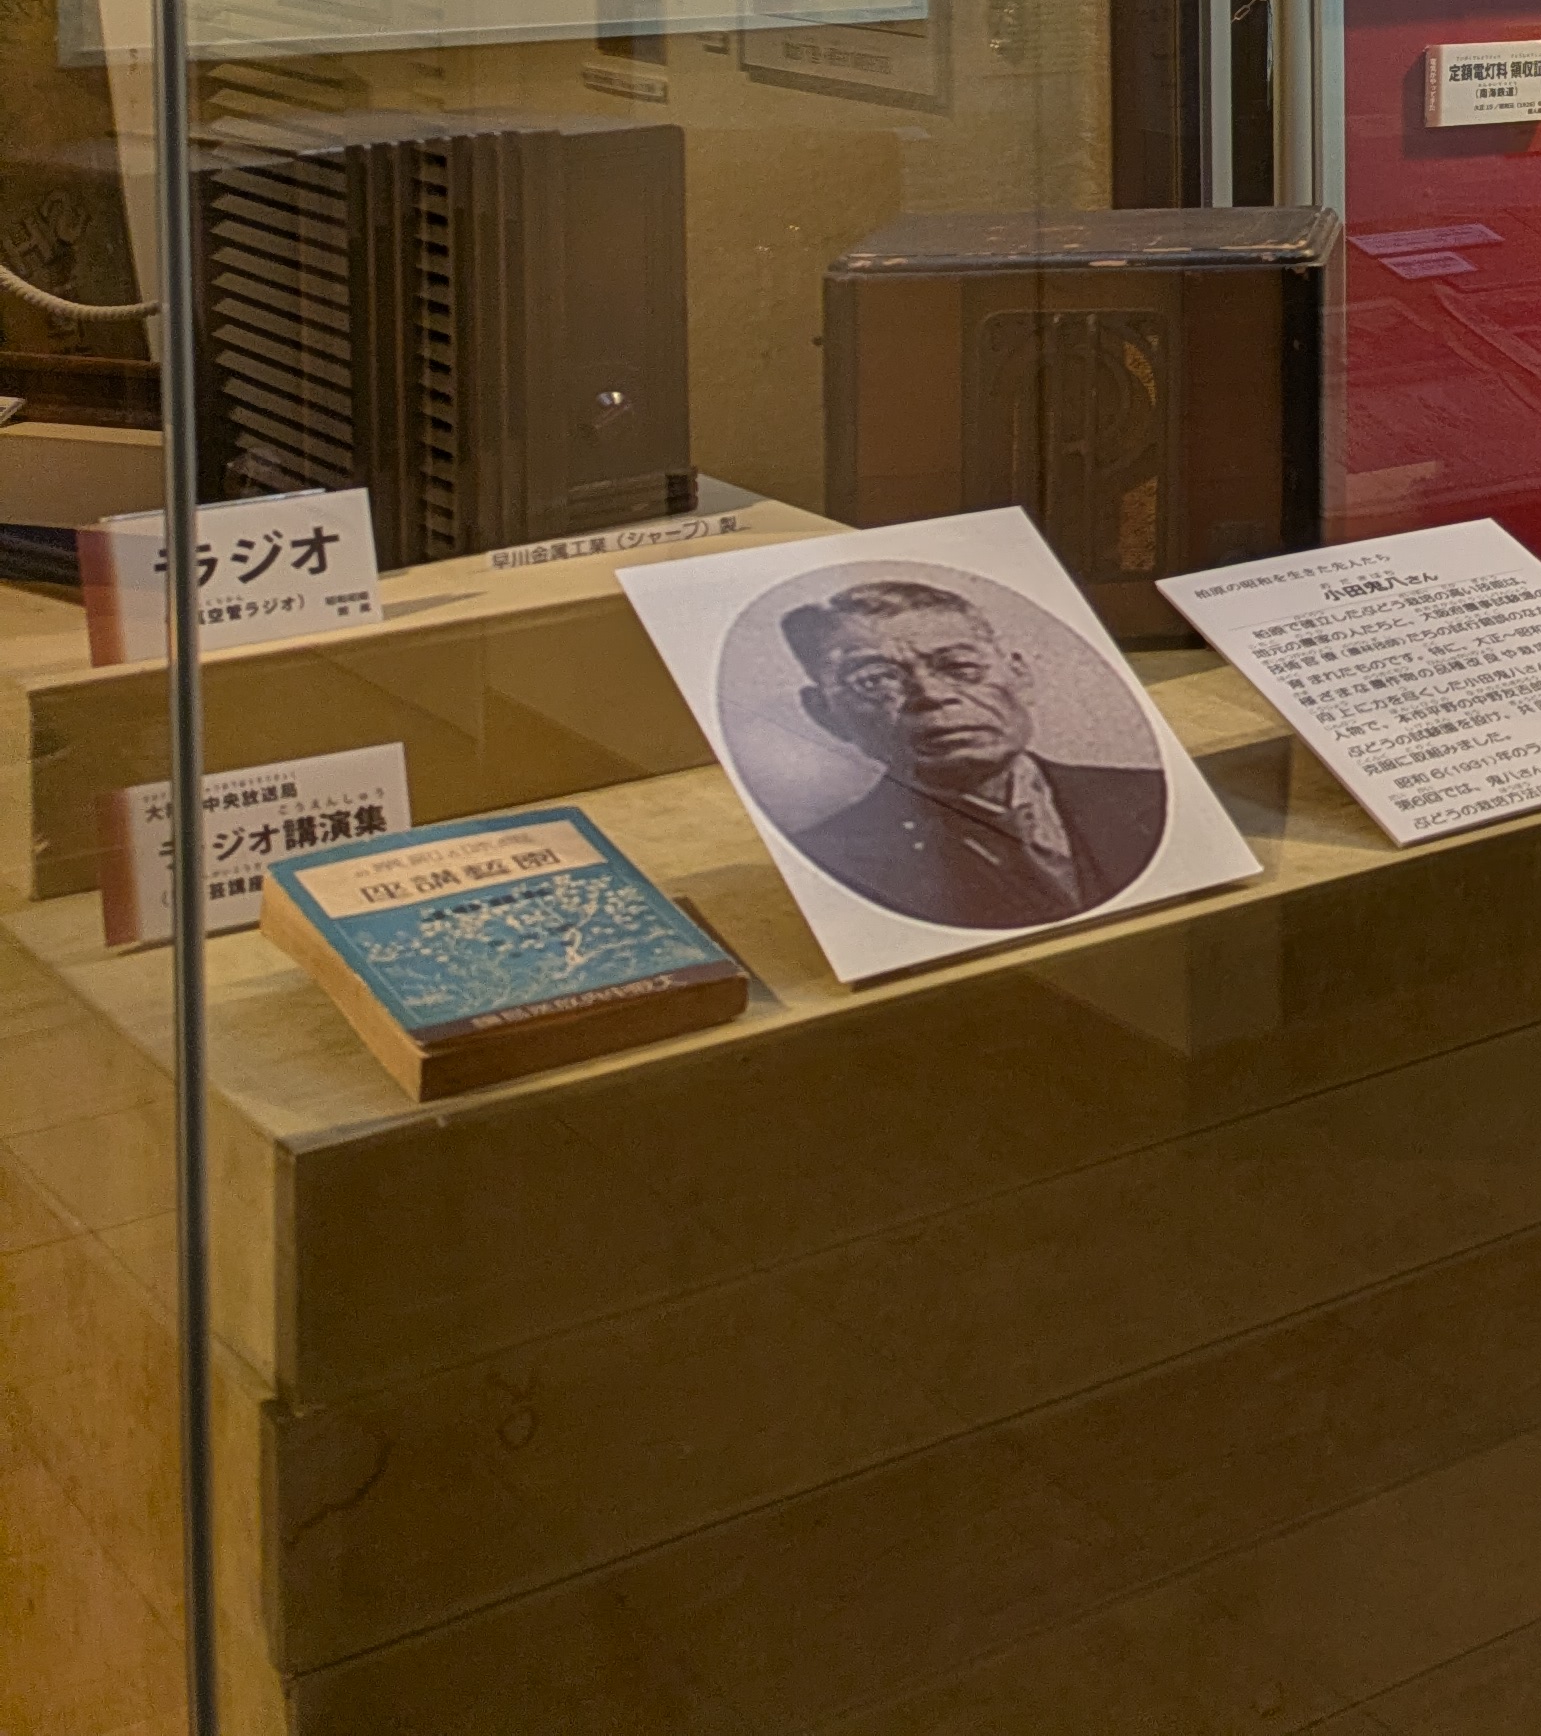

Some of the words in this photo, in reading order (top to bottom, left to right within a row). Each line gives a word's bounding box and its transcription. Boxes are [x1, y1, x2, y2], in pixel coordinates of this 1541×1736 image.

[1448, 61, 1509, 83] 定額電灯料
[1323, 571, 1440, 602] 小田鬼八さん
